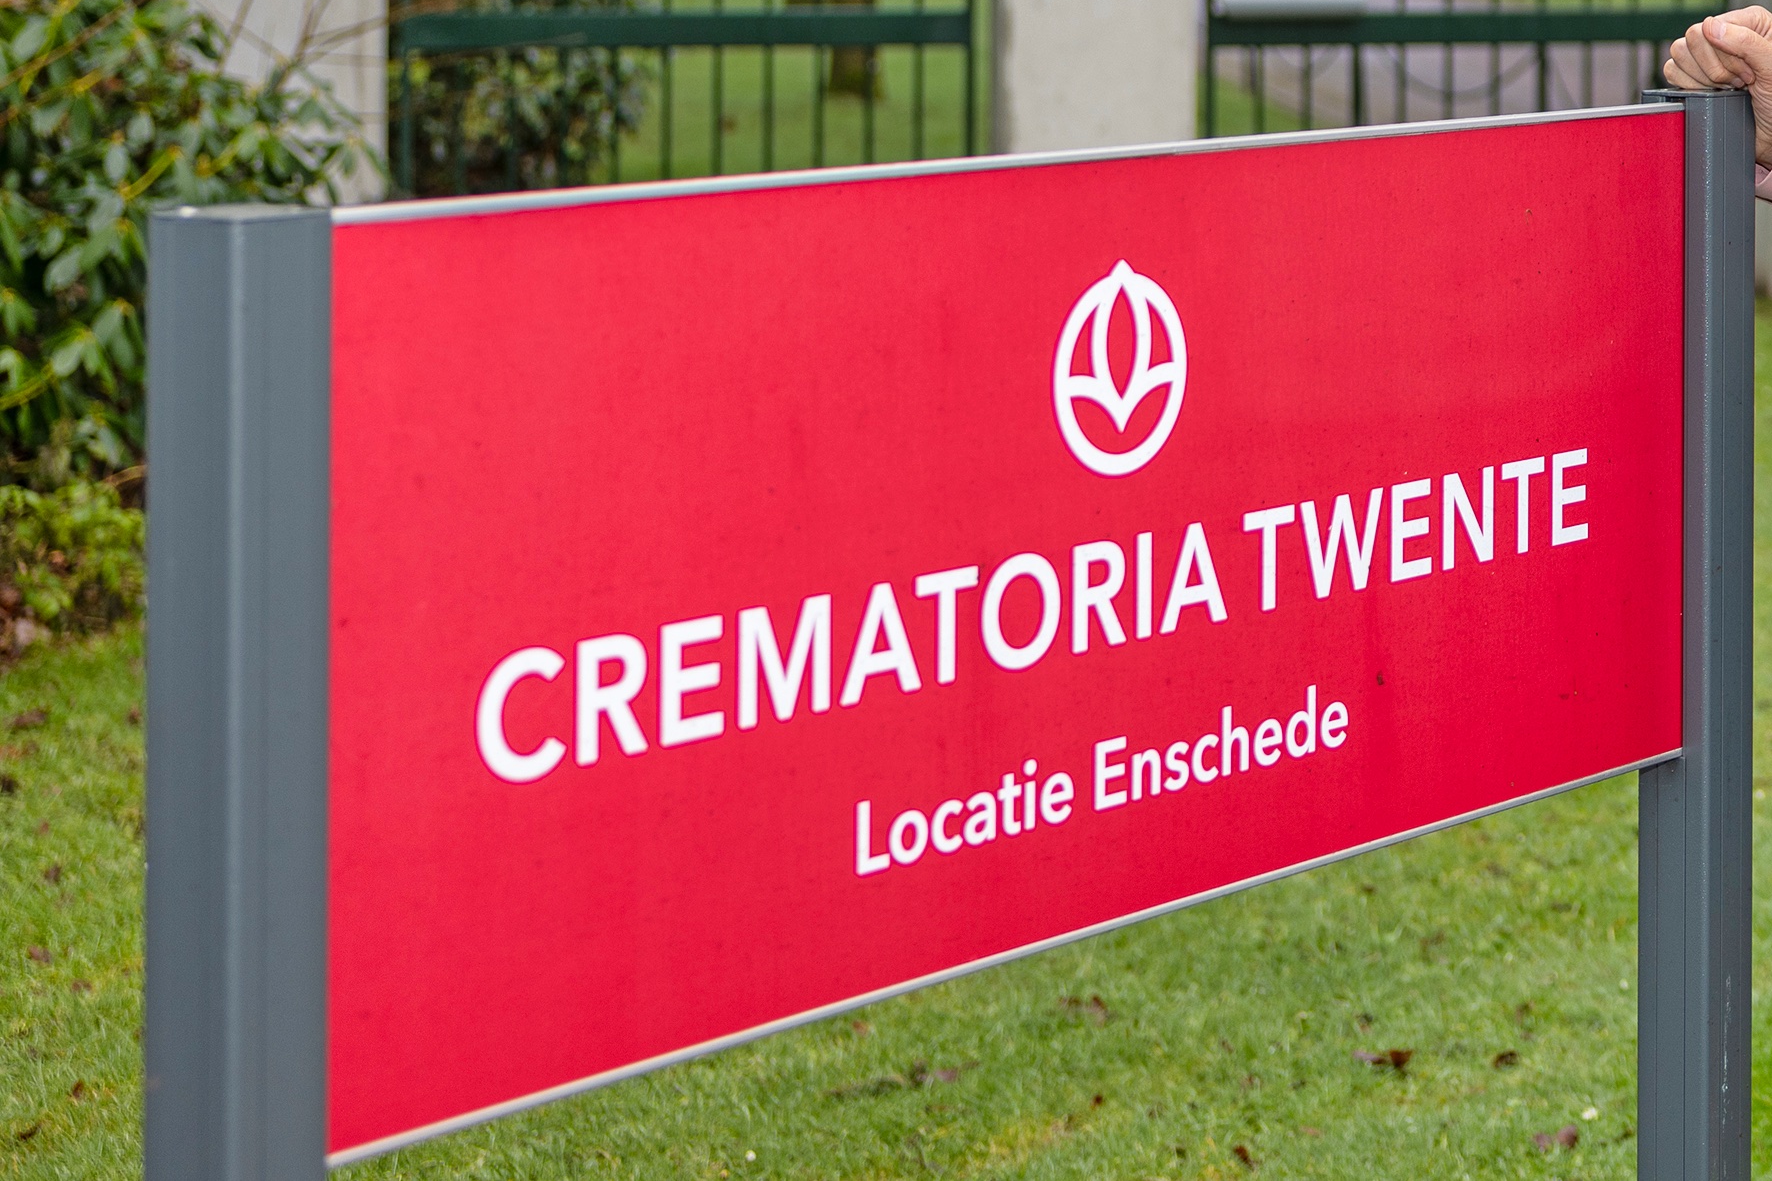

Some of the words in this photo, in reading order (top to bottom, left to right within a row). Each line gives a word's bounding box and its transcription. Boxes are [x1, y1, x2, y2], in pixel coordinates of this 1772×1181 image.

[477, 522, 1228, 782] CREMATORIA
[1243, 447, 1589, 611] TWENTE
[855, 759, 1074, 876] Locatie
[1094, 684, 1350, 811] Enschede
